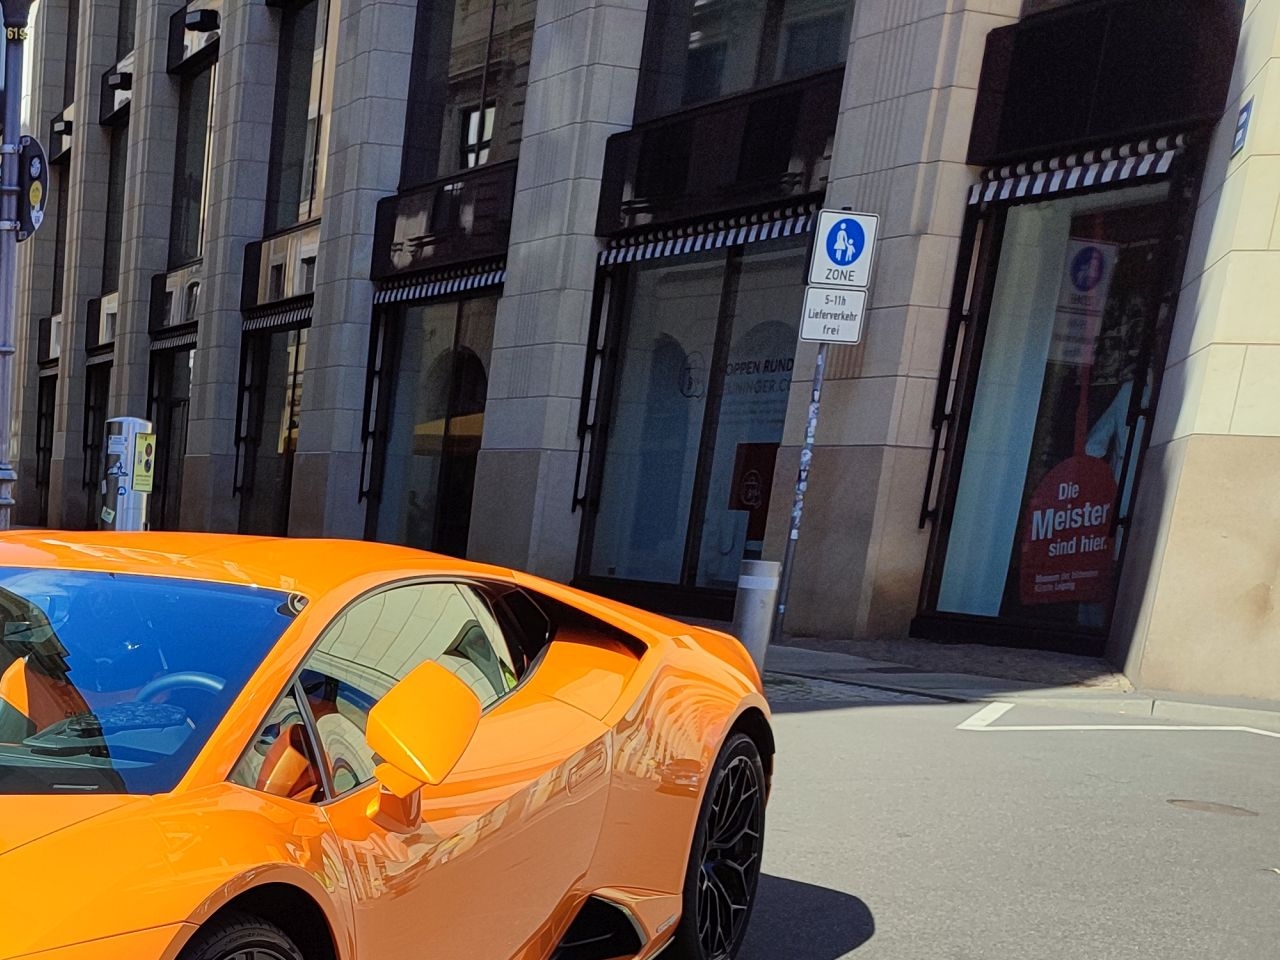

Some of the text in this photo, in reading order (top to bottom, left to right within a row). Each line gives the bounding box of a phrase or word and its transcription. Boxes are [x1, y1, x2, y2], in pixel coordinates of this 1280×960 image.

[825, 268, 856, 282] ZONE
[825, 294, 847, 306] 5-11h
[808, 308, 858, 322] Lieferverkehr
[822, 324, 840, 336] frei
[763, 358, 795, 375] RUND
[1058, 482, 1079, 500] Die
[1031, 502, 1111, 541] Meister
[1048, 534, 1107, 557] sind hier.
